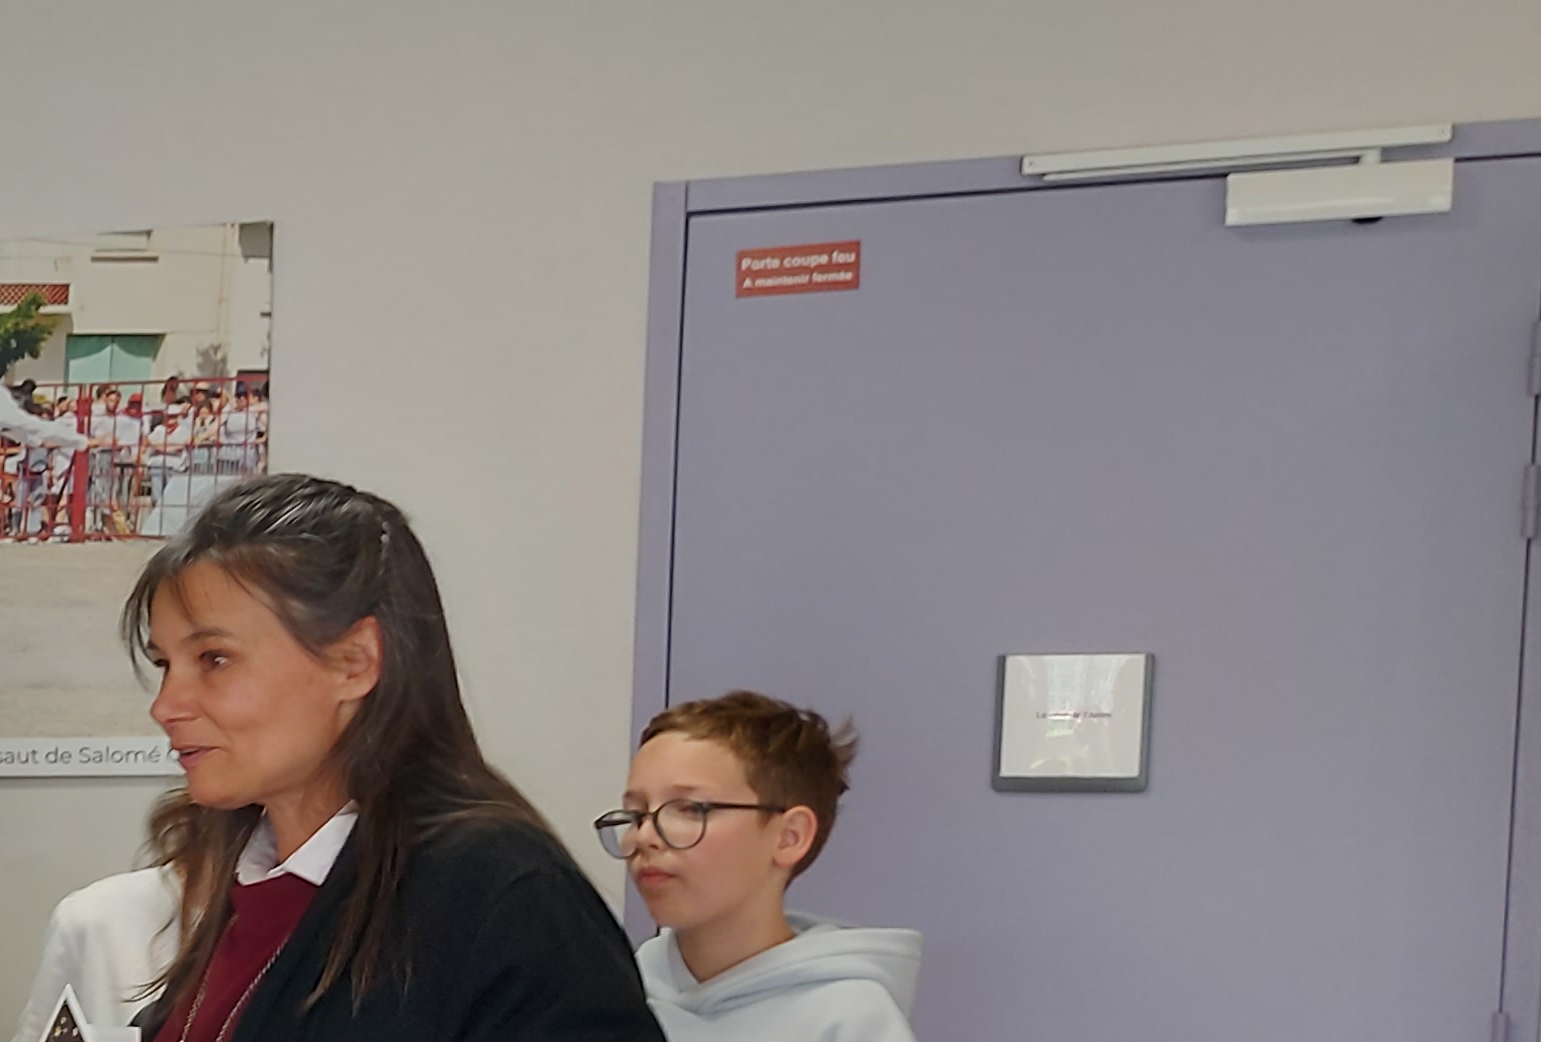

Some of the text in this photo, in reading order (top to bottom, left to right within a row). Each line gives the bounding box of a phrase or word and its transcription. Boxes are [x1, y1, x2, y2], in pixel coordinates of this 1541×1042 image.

[783, 253, 829, 268] coupe
[44, 746, 72, 764] de
[78, 744, 161, 764] Salomé
